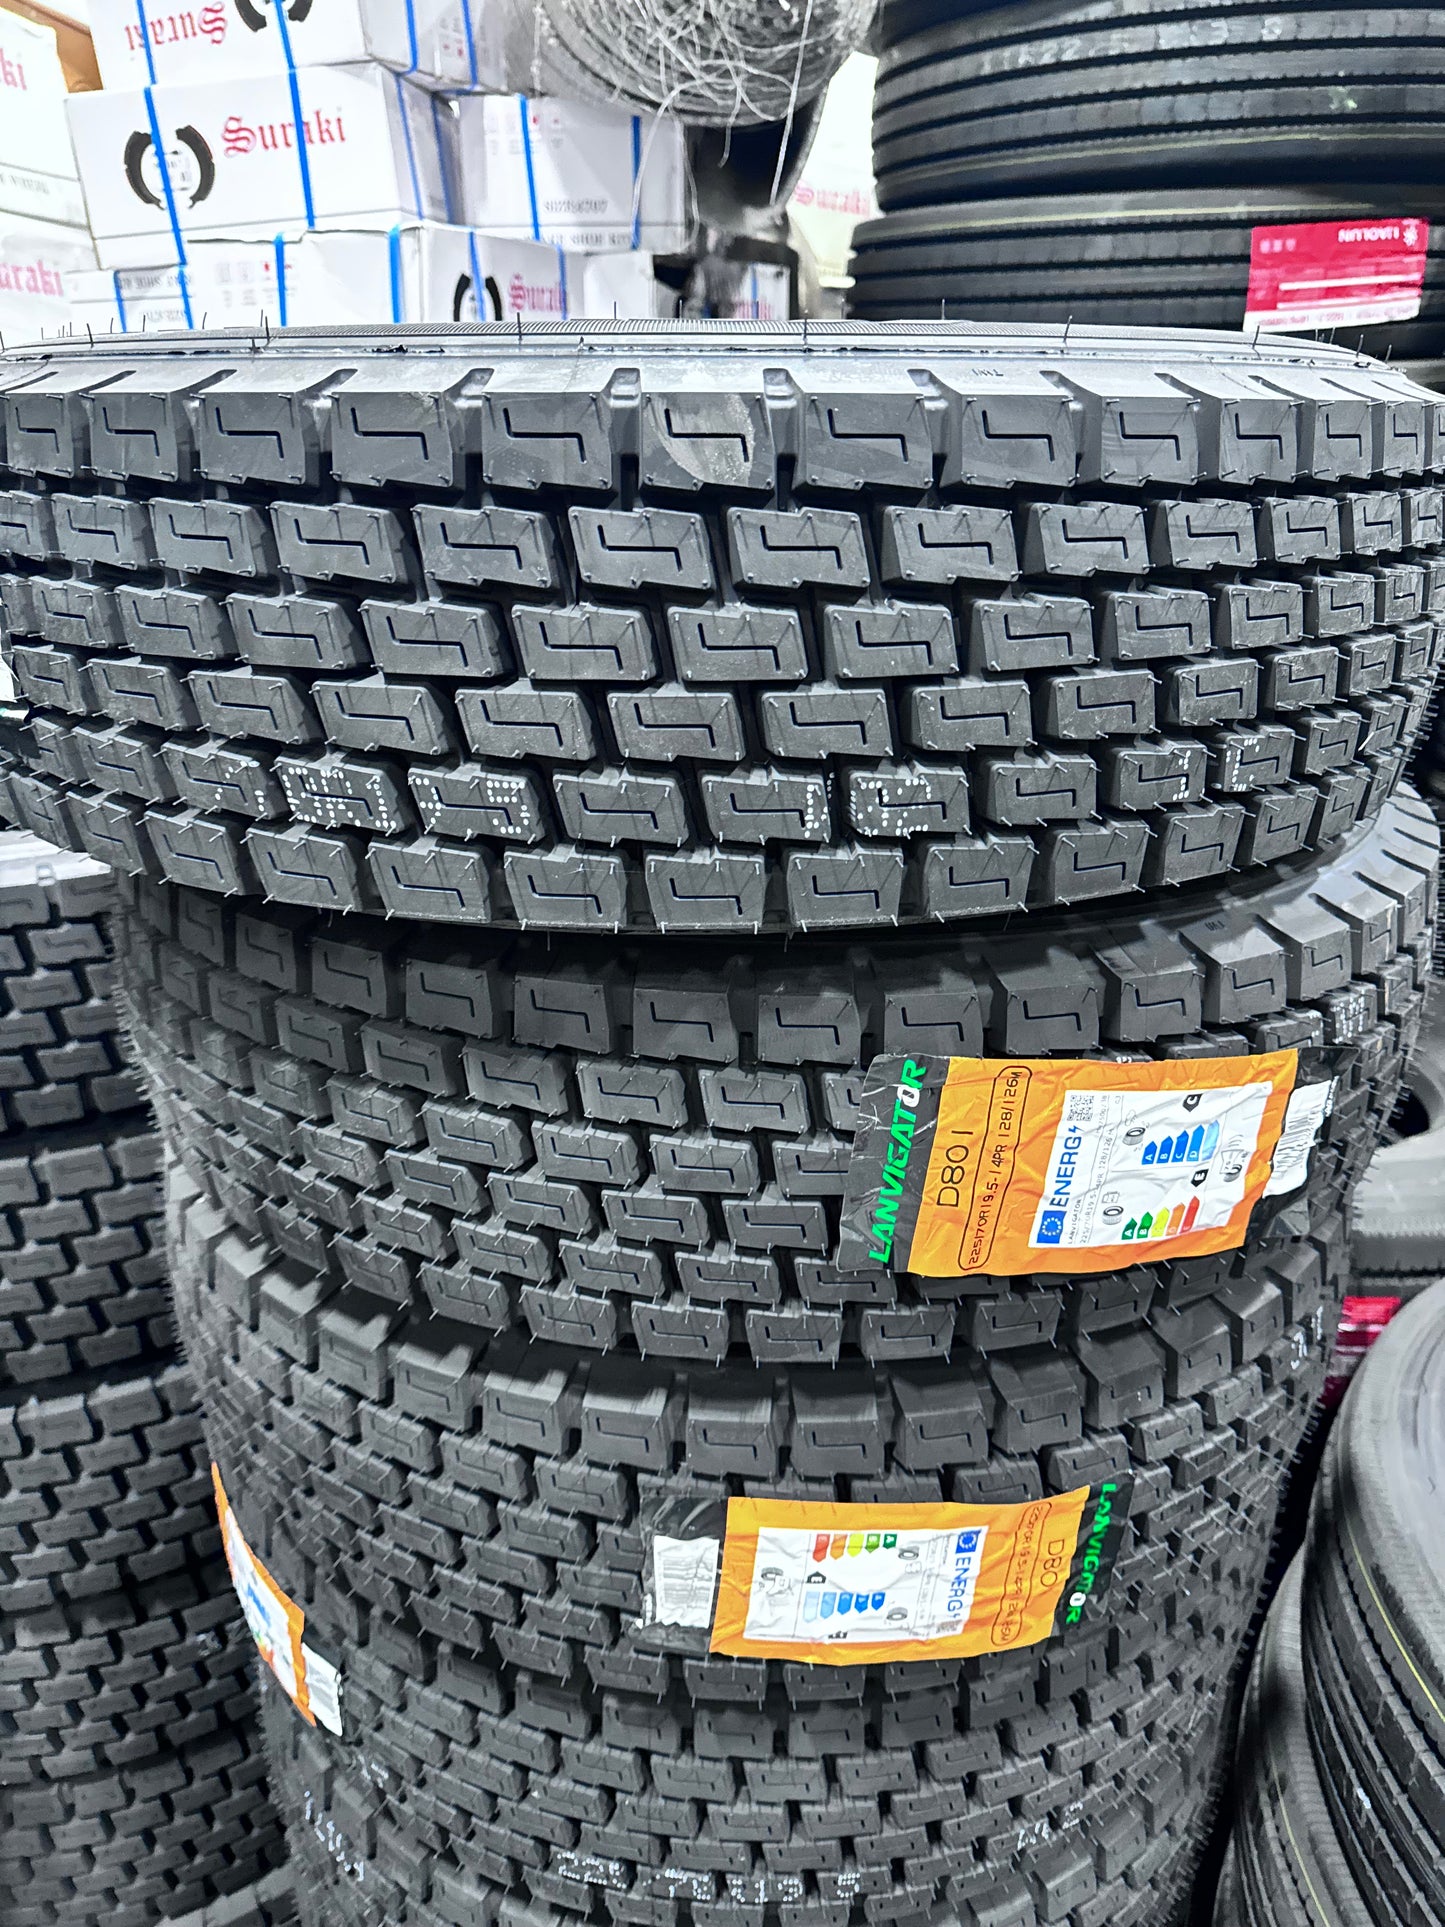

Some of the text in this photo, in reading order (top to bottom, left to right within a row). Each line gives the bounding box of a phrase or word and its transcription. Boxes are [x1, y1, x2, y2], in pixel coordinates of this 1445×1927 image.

[868, 1059, 927, 1264] LANVIGATOR
[1145, 1153, 1153, 1162] A
[1194, 1170, 1206, 1182] E
[1124, 1229, 1132, 1237] A
